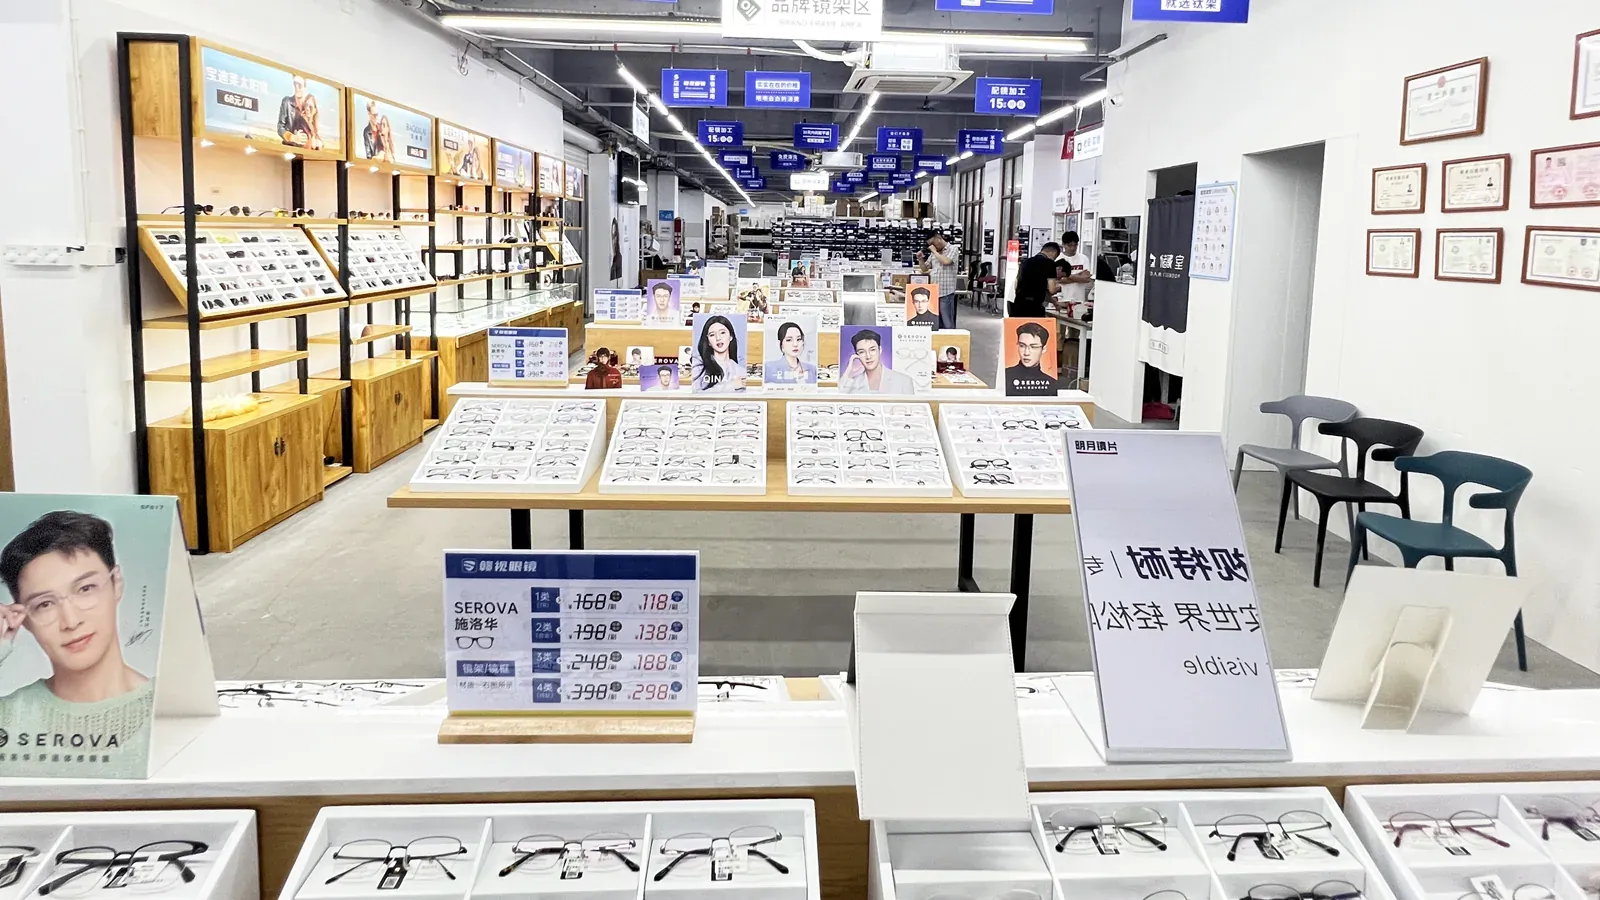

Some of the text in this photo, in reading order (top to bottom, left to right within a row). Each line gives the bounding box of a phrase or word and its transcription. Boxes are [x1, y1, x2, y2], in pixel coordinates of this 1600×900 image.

[771, 0, 872, 15] 品牌镜架区
[454, 601, 519, 614] SEROVA
[454, 617, 498, 630] 施洛华
[462, 663, 510, 674] 镜架/镜框
[17, 732, 119, 747] SEROVA
